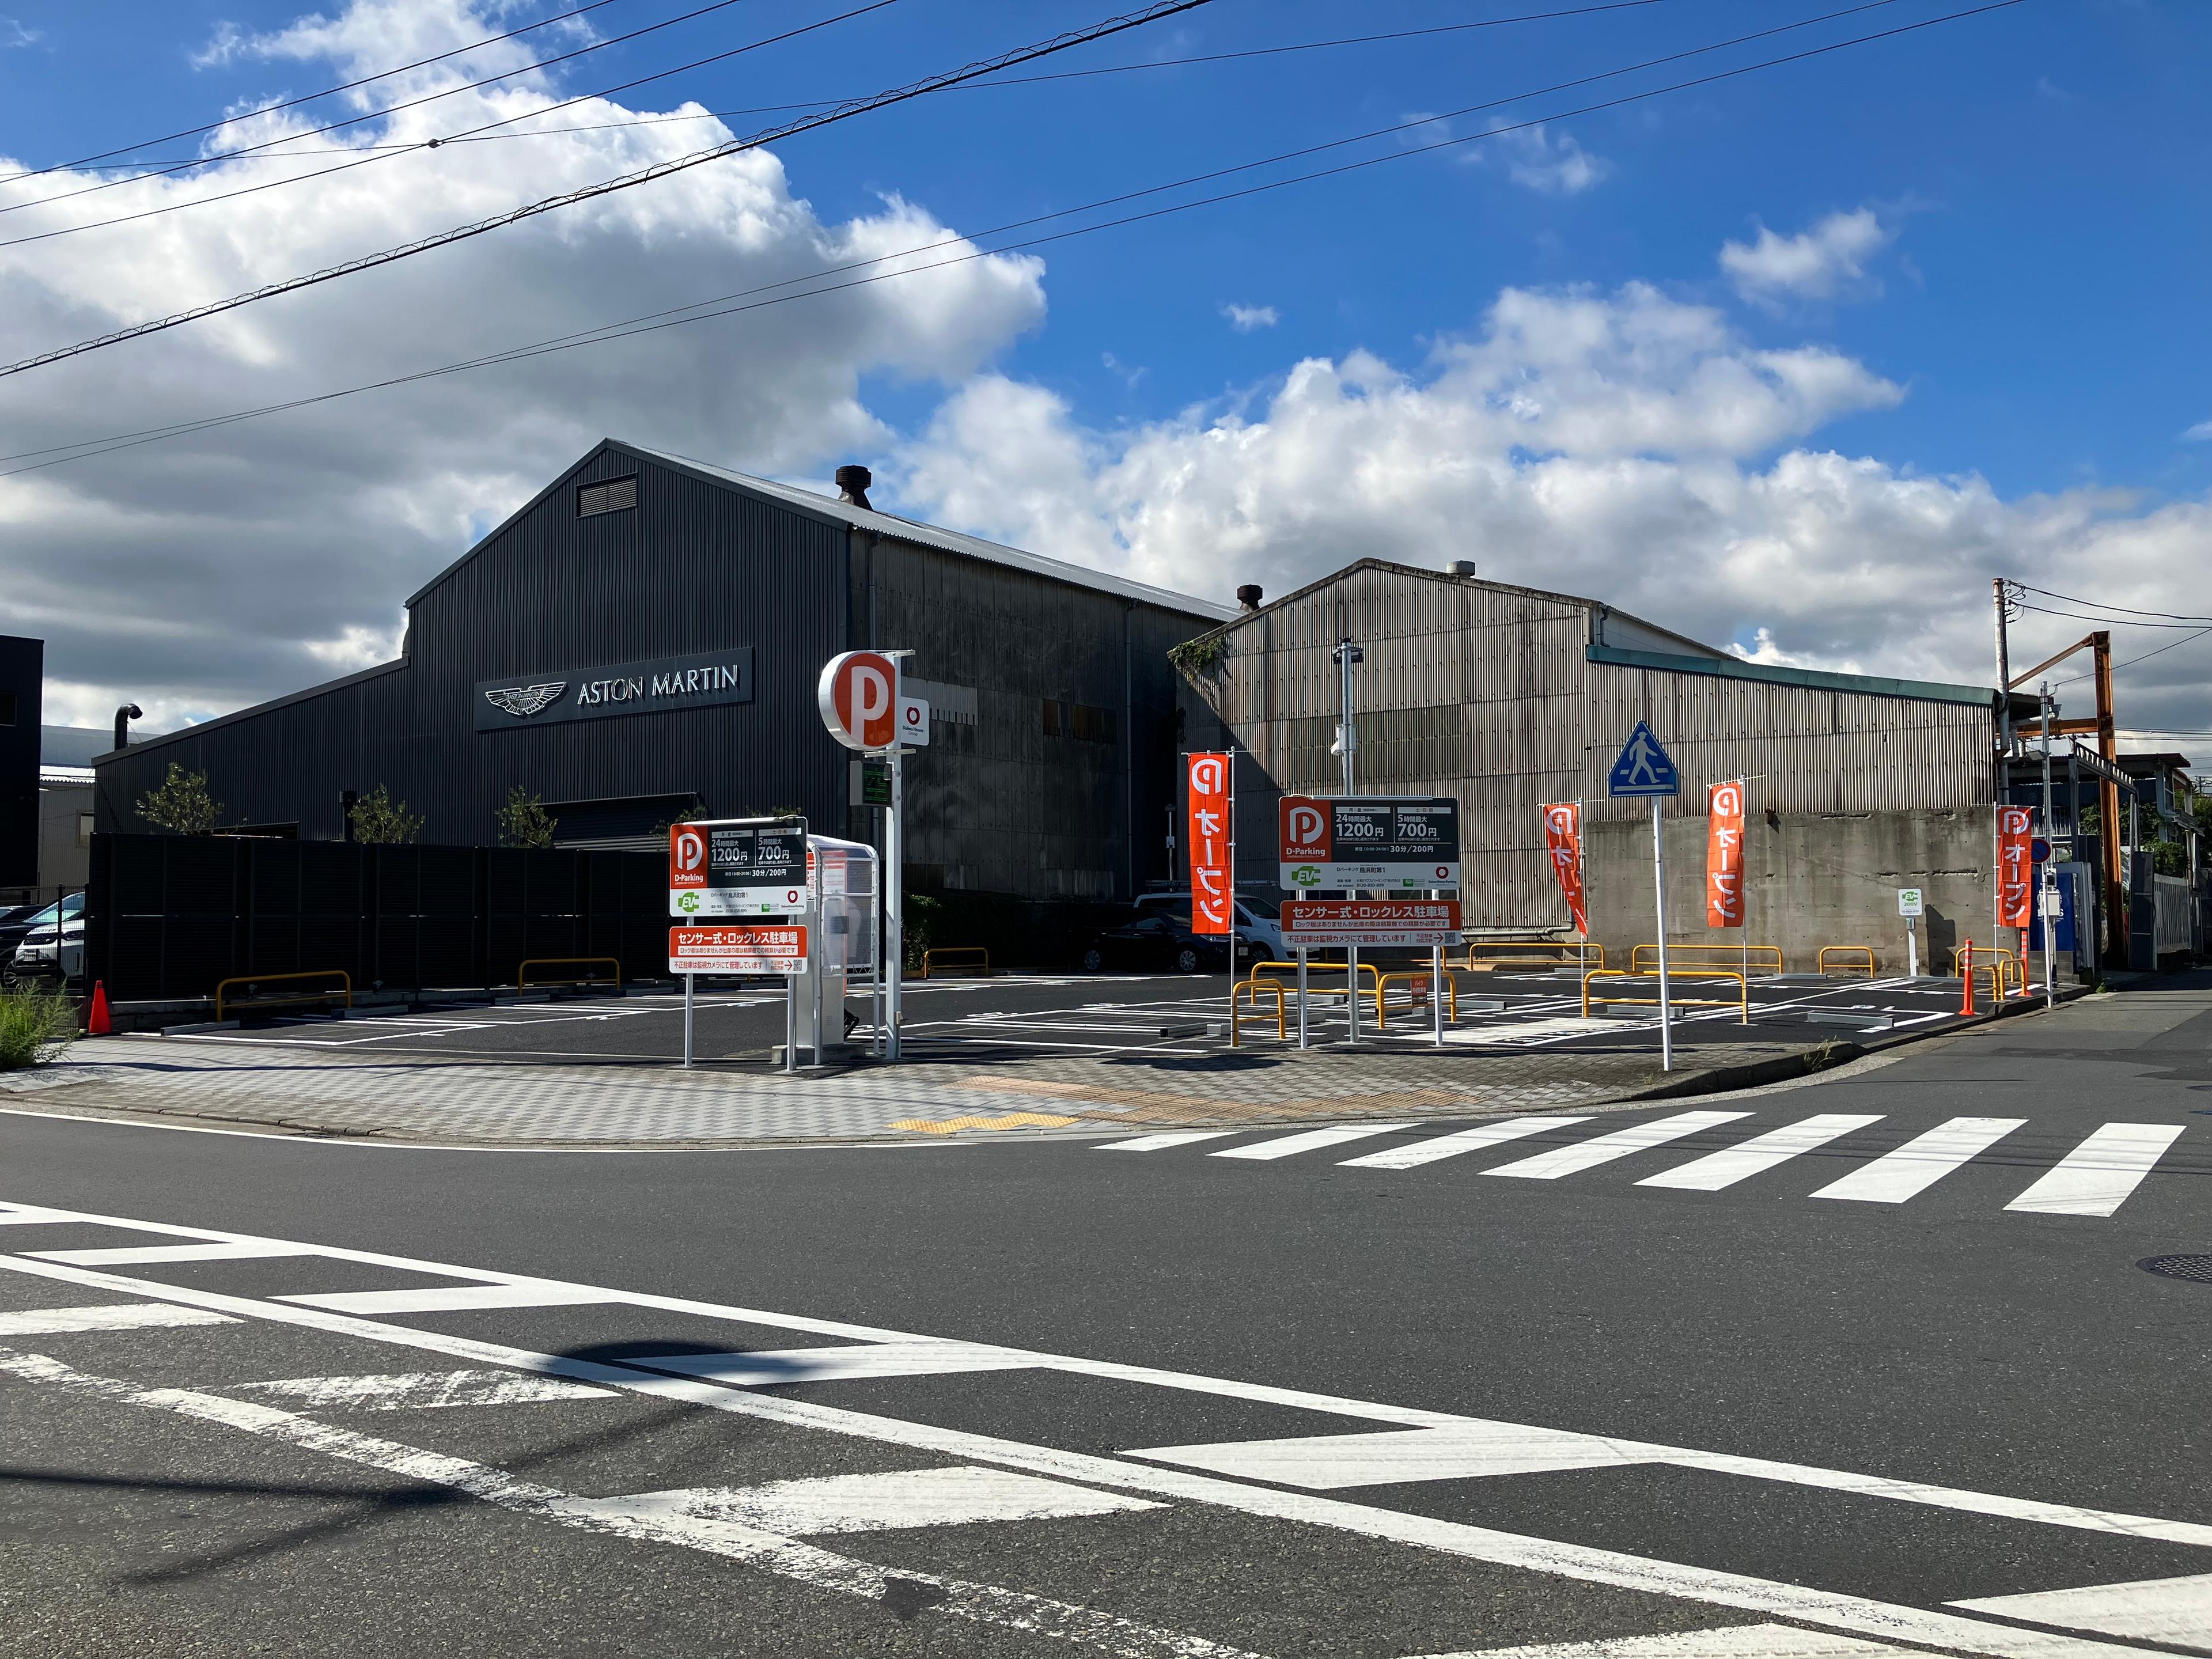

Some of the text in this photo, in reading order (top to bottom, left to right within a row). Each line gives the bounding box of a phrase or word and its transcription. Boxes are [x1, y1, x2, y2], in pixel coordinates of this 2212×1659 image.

[577, 664, 738, 706] ASTON MARTIN
[850, 665, 889, 744] P
[1336, 814, 1372, 823] 24時間最大
[1397, 814, 1427, 823] 5時間最大
[1336, 823, 1384, 837] 1200円
[1397, 823, 1437, 837] 700円
[711, 839, 739, 847] 24時間最大
[758, 837, 782, 846] 5時間最大
[711, 847, 748, 862] 1200円
[758, 846, 789, 860] 700円
[752, 869, 786, 877] 30分/200円
[1297, 870, 1315, 881] EV
[2004, 843, 2027, 920] オープン
[681, 897, 695, 908] EV
[1293, 906, 1449, 918] センサー式・ロックレス駐車場
[678, 931, 798, 944] センサー式・ロックレス駐車場
[1287, 934, 1406, 943] 不正駐車は監視カメラにて管理しています
[674, 961, 763, 969] 不正駐車は監視カメラにて管理しています
